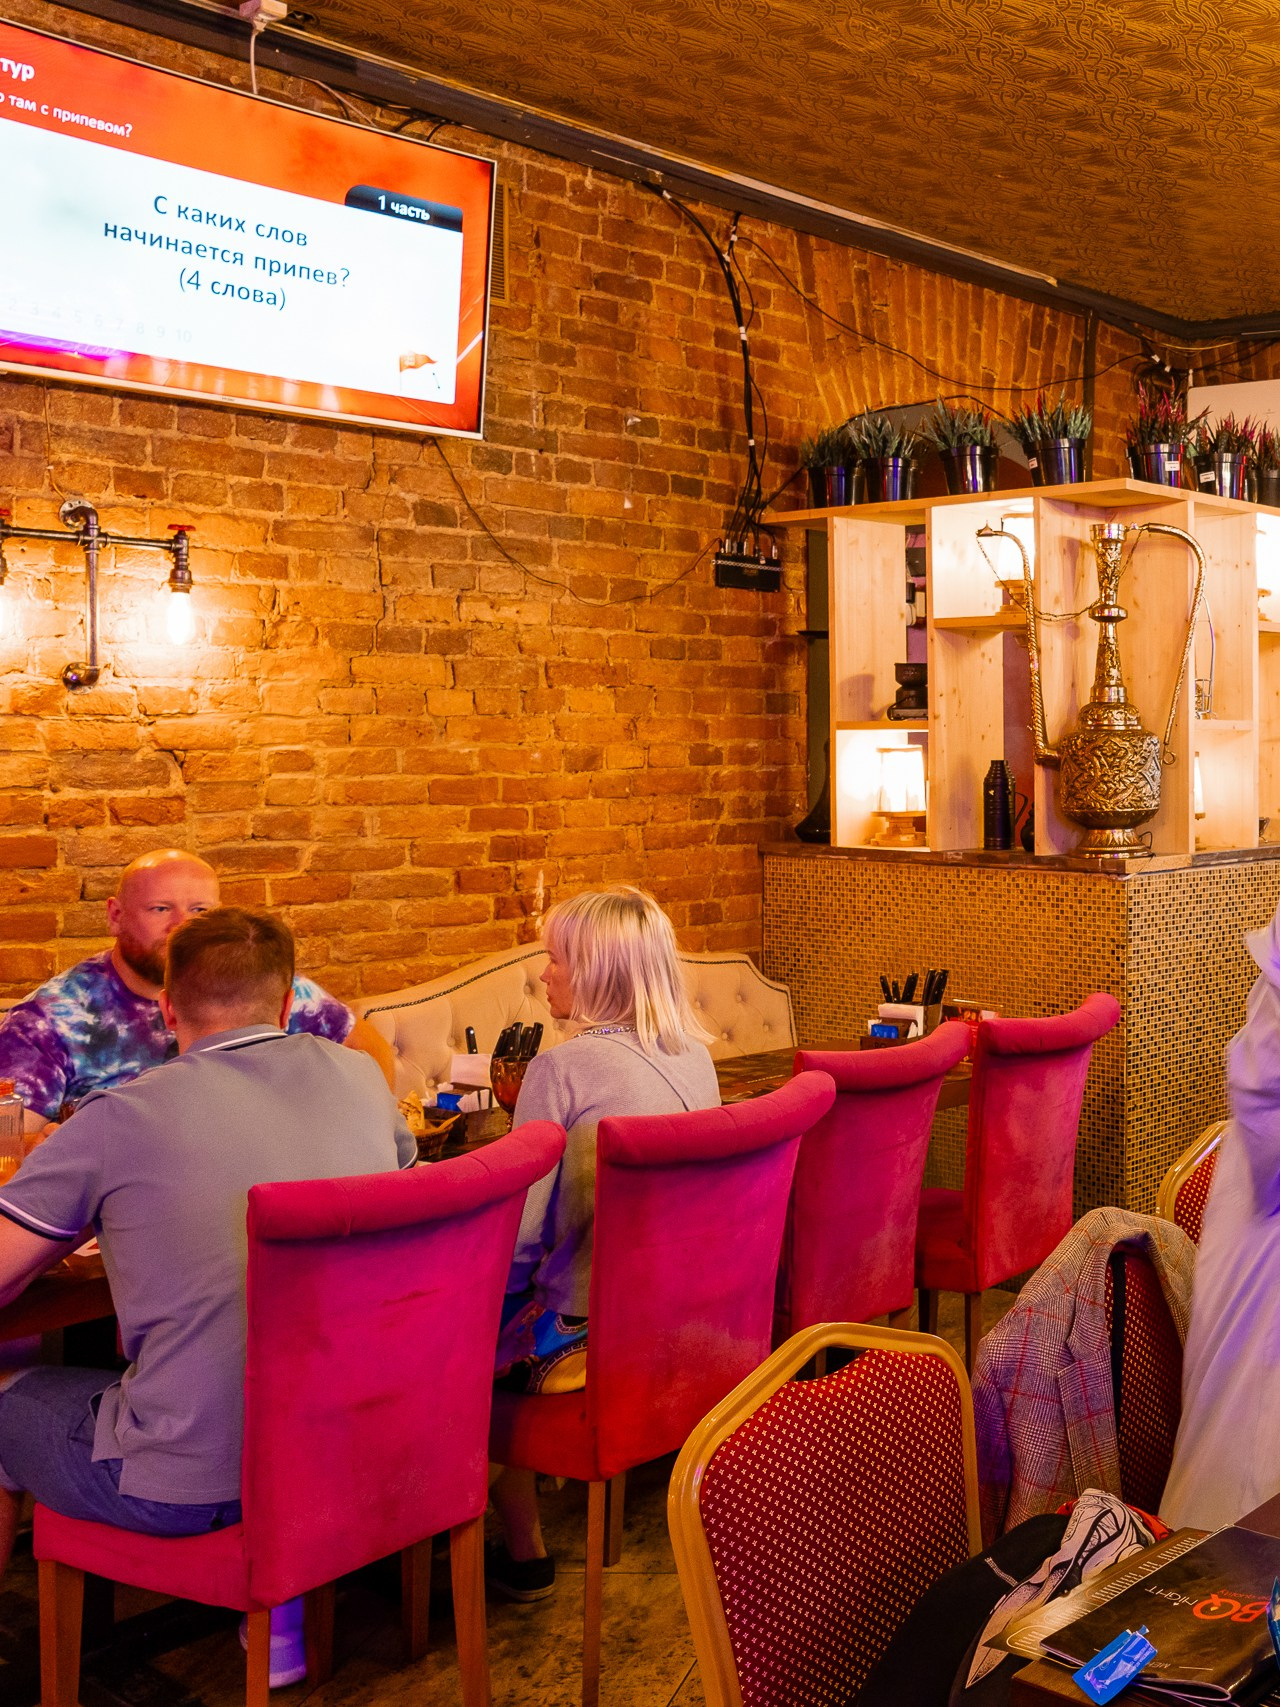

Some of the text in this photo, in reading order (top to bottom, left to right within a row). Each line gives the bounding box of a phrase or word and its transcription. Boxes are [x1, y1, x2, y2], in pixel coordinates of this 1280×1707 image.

[0, 57, 35, 82] тур
[8, 94, 37, 113] там
[40, 104, 49, 116] с
[52, 107, 133, 138] припевом?
[153, 195, 308, 247] С каких слов
[378, 194, 431, 222] 1 часть
[104, 222, 351, 289] начинается припев?
[179, 267, 287, 311] (4 слова)
[1192, 1593, 1270, 1622] BQ
